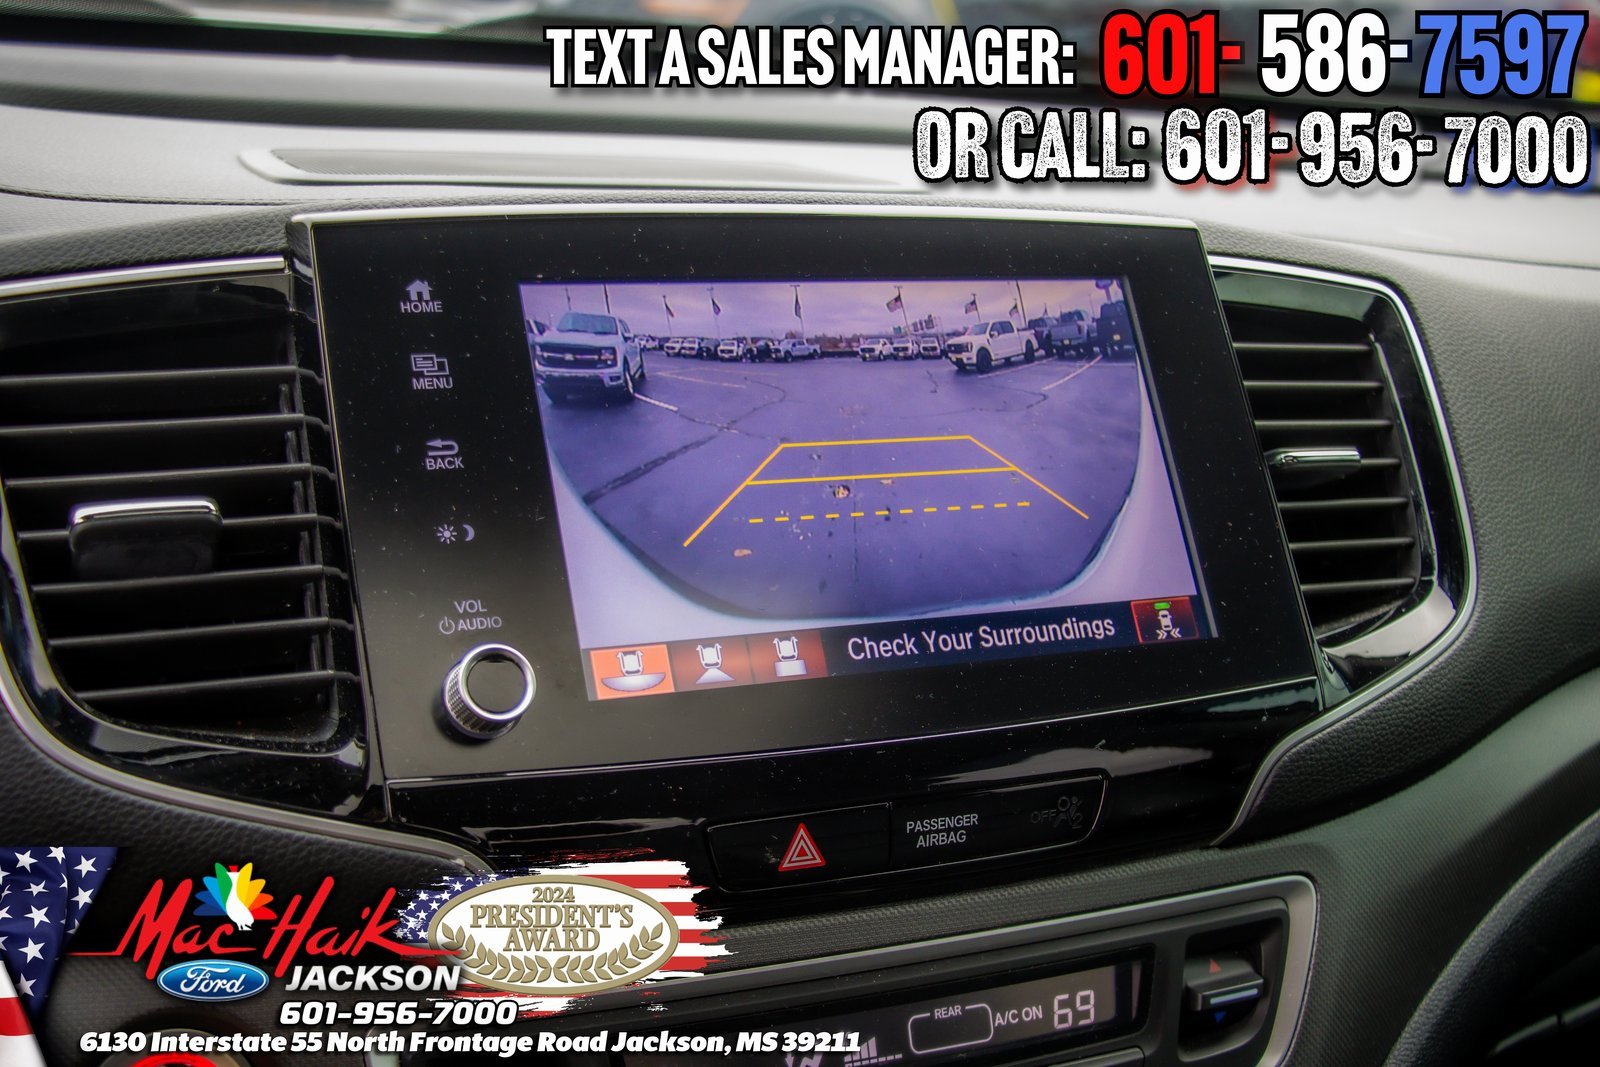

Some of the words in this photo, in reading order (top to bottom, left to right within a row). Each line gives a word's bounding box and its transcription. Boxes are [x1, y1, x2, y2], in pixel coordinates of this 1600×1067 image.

[401, 301, 442, 313] HOME
[412, 377, 453, 391] MENU
[425, 456, 464, 471] BACK
[454, 600, 487, 614] VOL
[457, 616, 502, 632] AUDIO
[848, 632, 918, 661] Check
[921, 625, 973, 652] Your
[978, 615, 1116, 648] Surroundings
[906, 813, 979, 834] PASSENGER
[916, 829, 967, 849] AIRBAG
[934, 1005, 962, 1019] REAR
[995, 1012, 1018, 1027] A/C
[1022, 1005, 1043, 1021] ON
[1053, 989, 1095, 1030] 69
